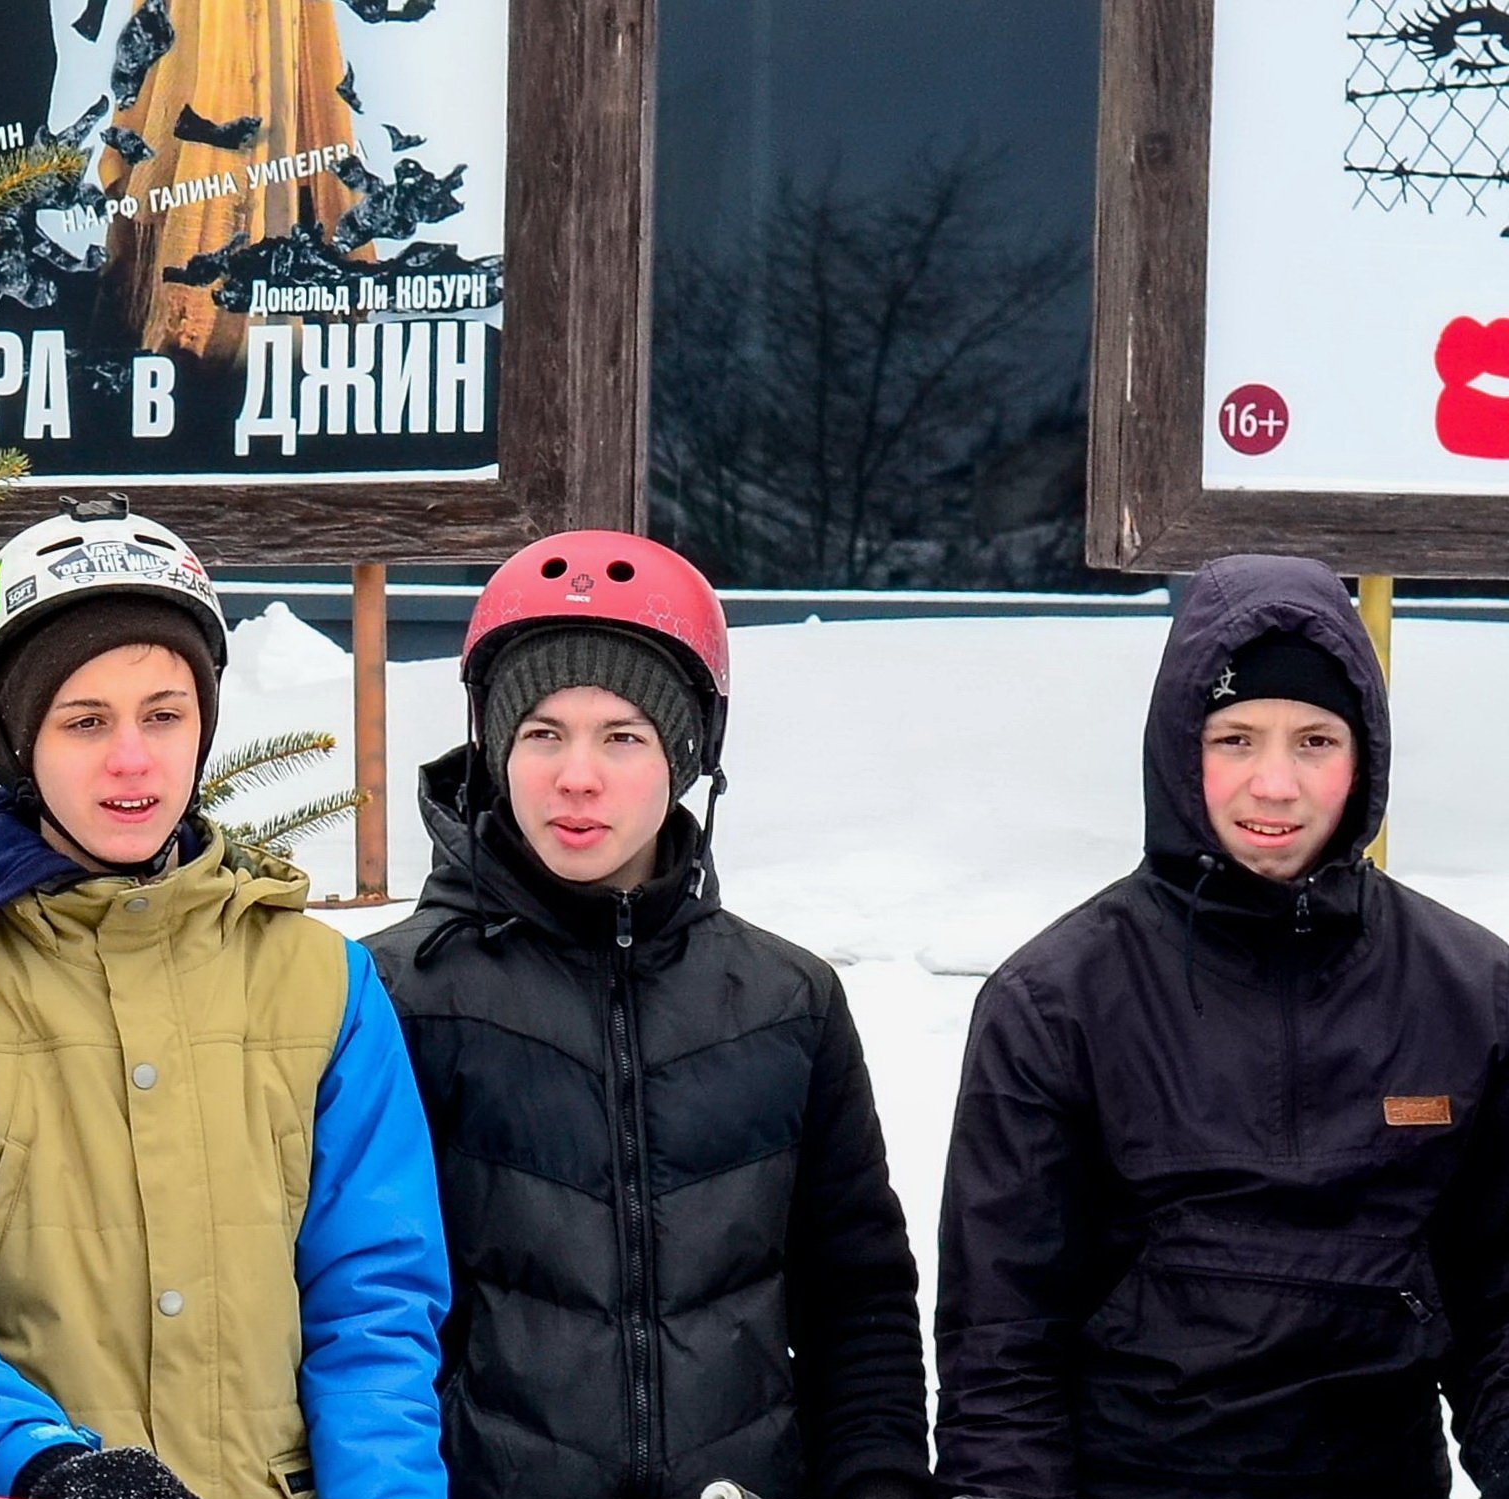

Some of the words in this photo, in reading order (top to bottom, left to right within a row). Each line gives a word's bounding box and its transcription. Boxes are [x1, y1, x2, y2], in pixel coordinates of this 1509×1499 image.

[149, 171, 238, 214] ГАЛИНА
[249, 278, 351, 319] Дональд
[357, 276, 389, 311] Ли
[396, 274, 488, 312] КОБУРН
[234, 320, 486, 457] ДЖИН
[1223, 402, 1285, 438] 16+
[83, 542, 132, 559] VANS
[90, 554, 126, 573] THE
